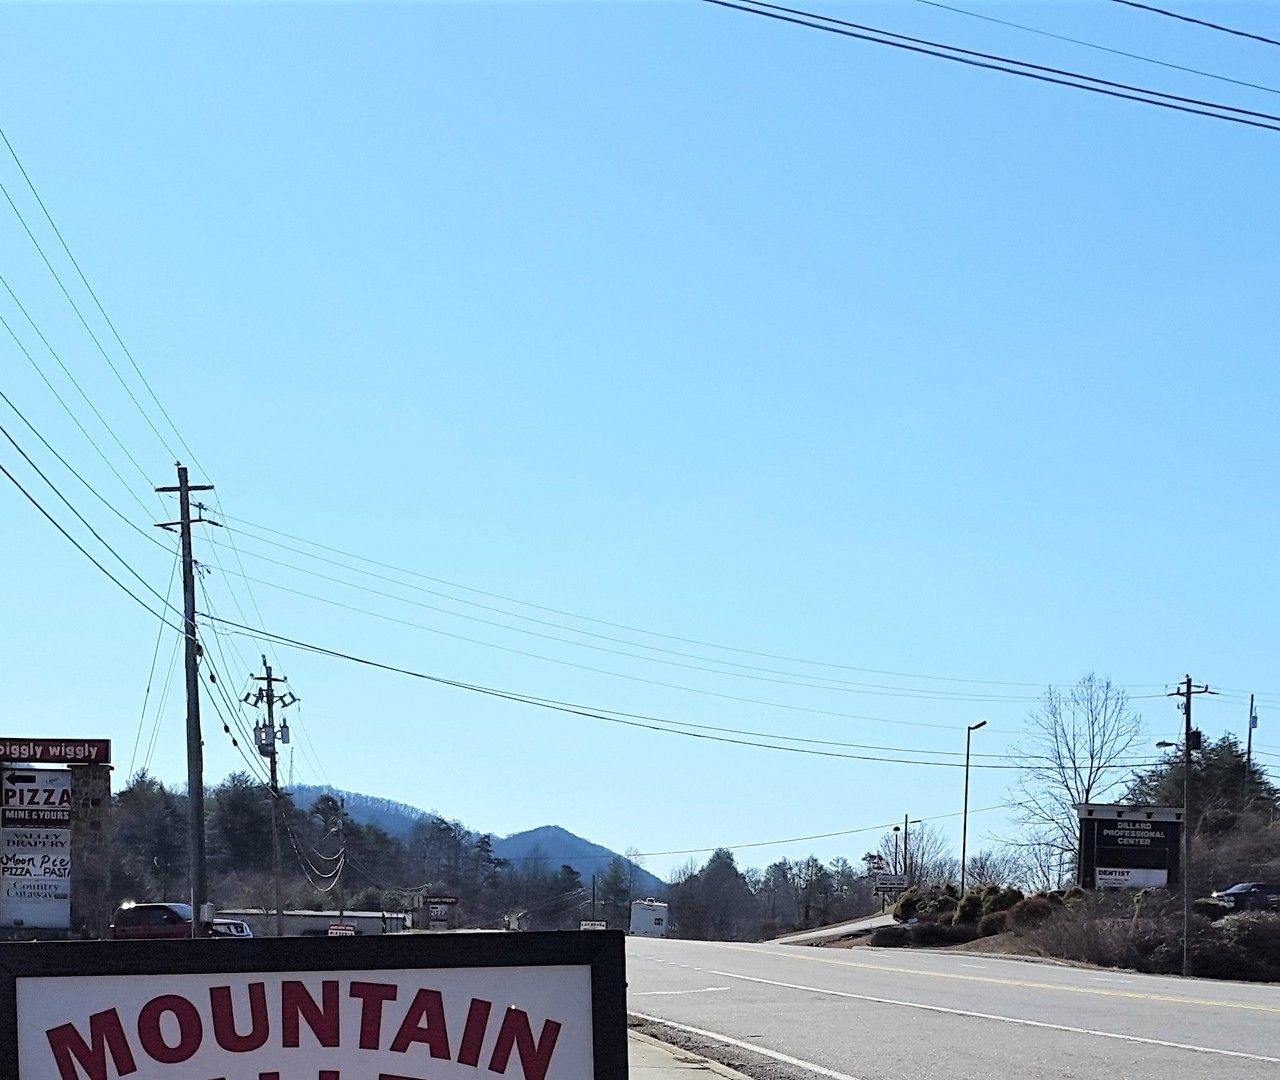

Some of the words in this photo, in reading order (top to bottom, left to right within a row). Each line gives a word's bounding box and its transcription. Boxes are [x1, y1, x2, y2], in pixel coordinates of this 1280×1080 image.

[48, 743, 98, 760] wiggly
[4, 788, 72, 806] PIZZA
[6, 810, 31, 819] MINE
[39, 811, 69, 820] YOURS
[1117, 822, 1152, 830] DILLARD
[1103, 829, 1166, 838] PROFESSIONAL
[6, 839, 67, 848] DRAPERY
[1117, 838, 1151, 846] CENTER
[1, 853, 36, 868] Moon
[40, 855, 70, 868] Pie
[1098, 869, 1131, 877] DENTIST
